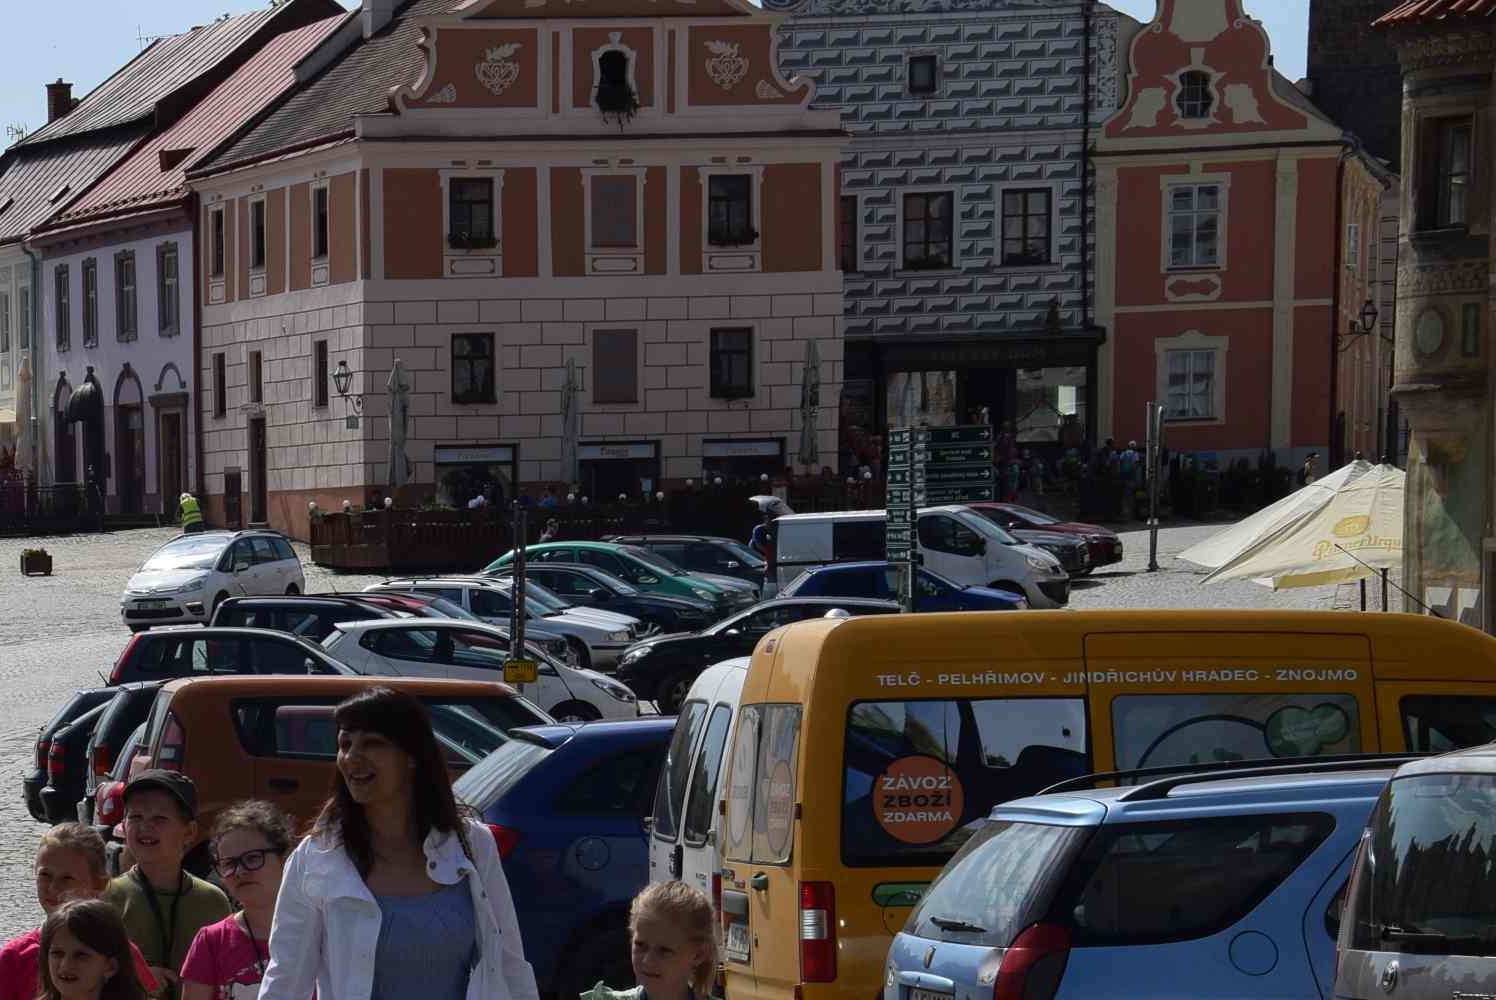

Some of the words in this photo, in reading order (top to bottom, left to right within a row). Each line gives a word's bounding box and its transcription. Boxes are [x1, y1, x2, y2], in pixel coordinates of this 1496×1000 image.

[877, 672, 921, 686] TELČ
[938, 670, 1045, 685] PELHŘIMOV
[1063, 668, 1177, 684] JINDŘICHŮV
[1182, 669, 1260, 682] HRADEC
[1276, 669, 1358, 682] ZNOJMO
[882, 774, 953, 790] ZÁVOZ
[884, 790, 952, 808] ZBOŽÍ
[883, 811, 953, 823] ZDARMA
